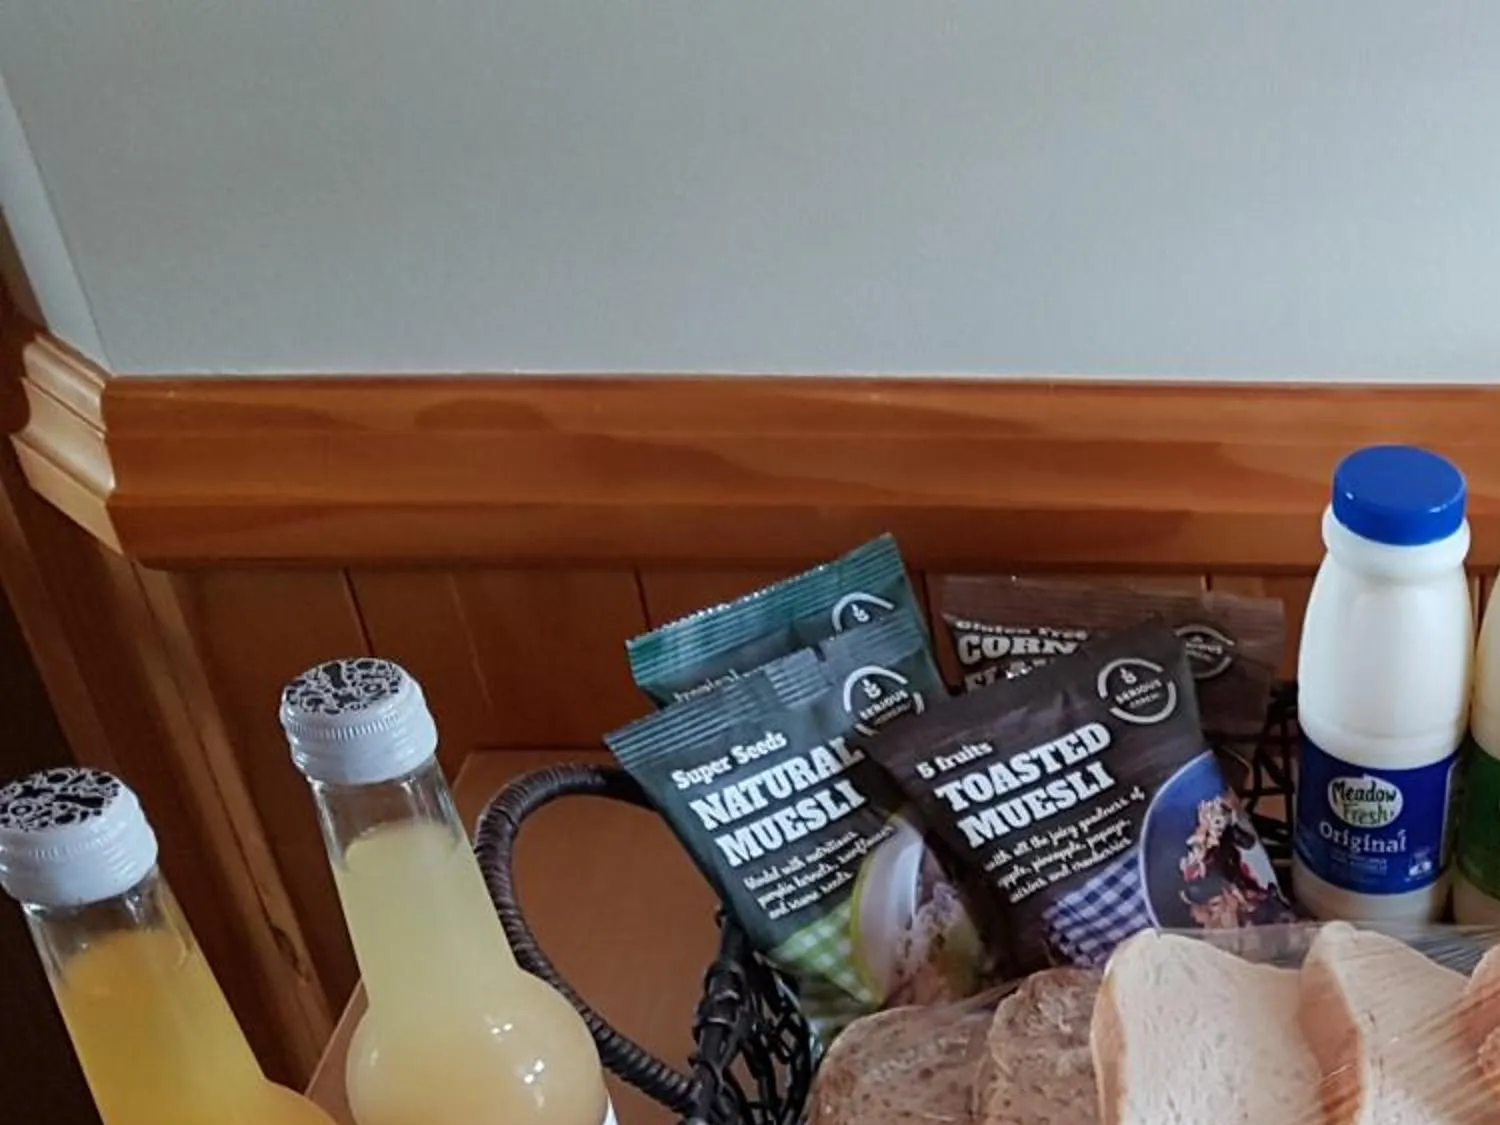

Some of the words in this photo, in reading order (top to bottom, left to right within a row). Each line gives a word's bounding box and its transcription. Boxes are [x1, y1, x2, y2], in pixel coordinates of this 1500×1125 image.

[957, 634, 1080, 666] CORN
[671, 754, 732, 791] Super
[730, 729, 789, 765] Seeds
[690, 735, 866, 831] NATURAL
[915, 761, 935, 780] 5
[935, 739, 993, 772] fruits
[934, 721, 1113, 813] TOASTED
[957, 761, 1116, 849] MUESLI
[1331, 780, 1398, 803] Meadow
[1343, 803, 1391, 825] Fresh
[714, 779, 867, 868] MUESLI
[1318, 821, 1408, 854] Original
